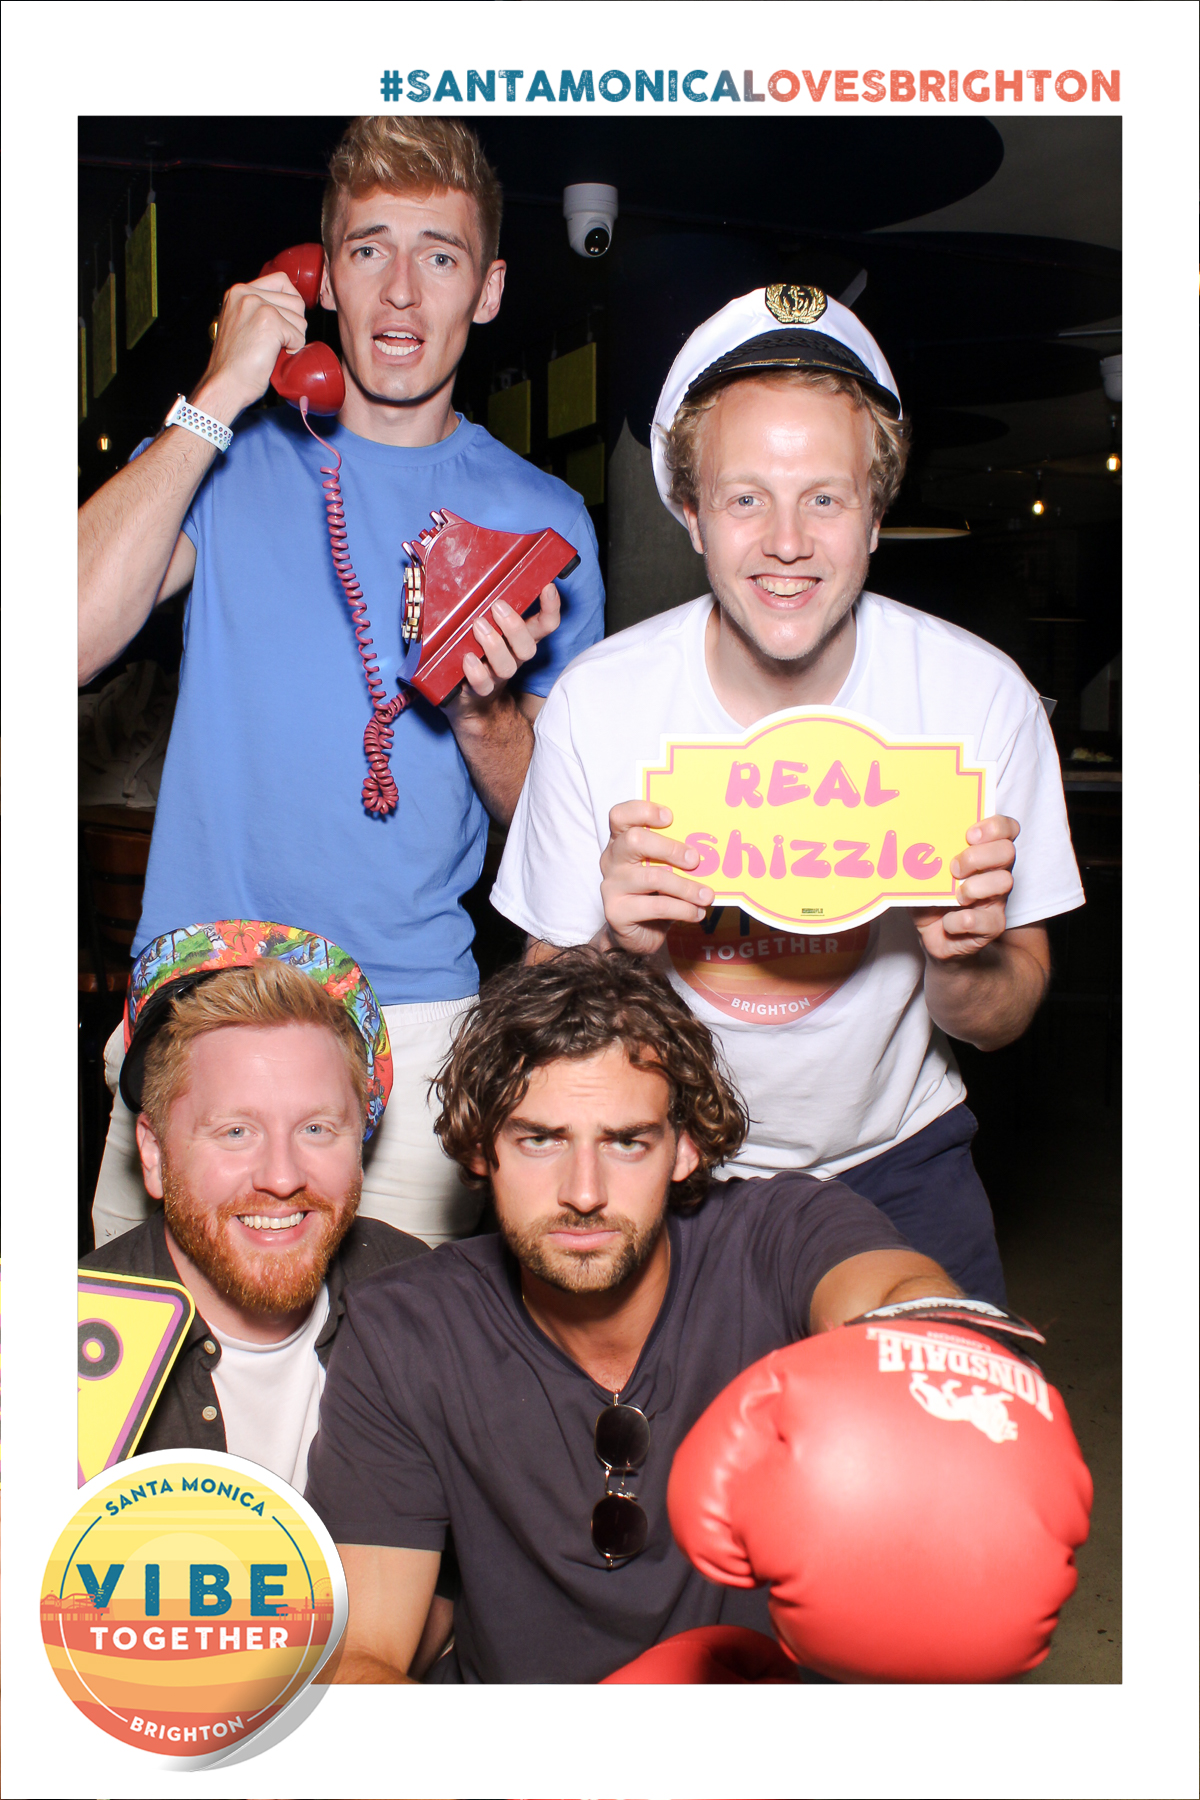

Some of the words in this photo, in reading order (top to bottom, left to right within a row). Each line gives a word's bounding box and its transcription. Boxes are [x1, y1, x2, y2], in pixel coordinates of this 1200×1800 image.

[725, 760, 900, 809] REAL
[684, 829, 942, 880] Shizzle
[702, 937, 839, 961] TOGETHER
[731, 997, 811, 1016] BRIGHTON
[874, 1334, 1054, 1422] LONSDALE
